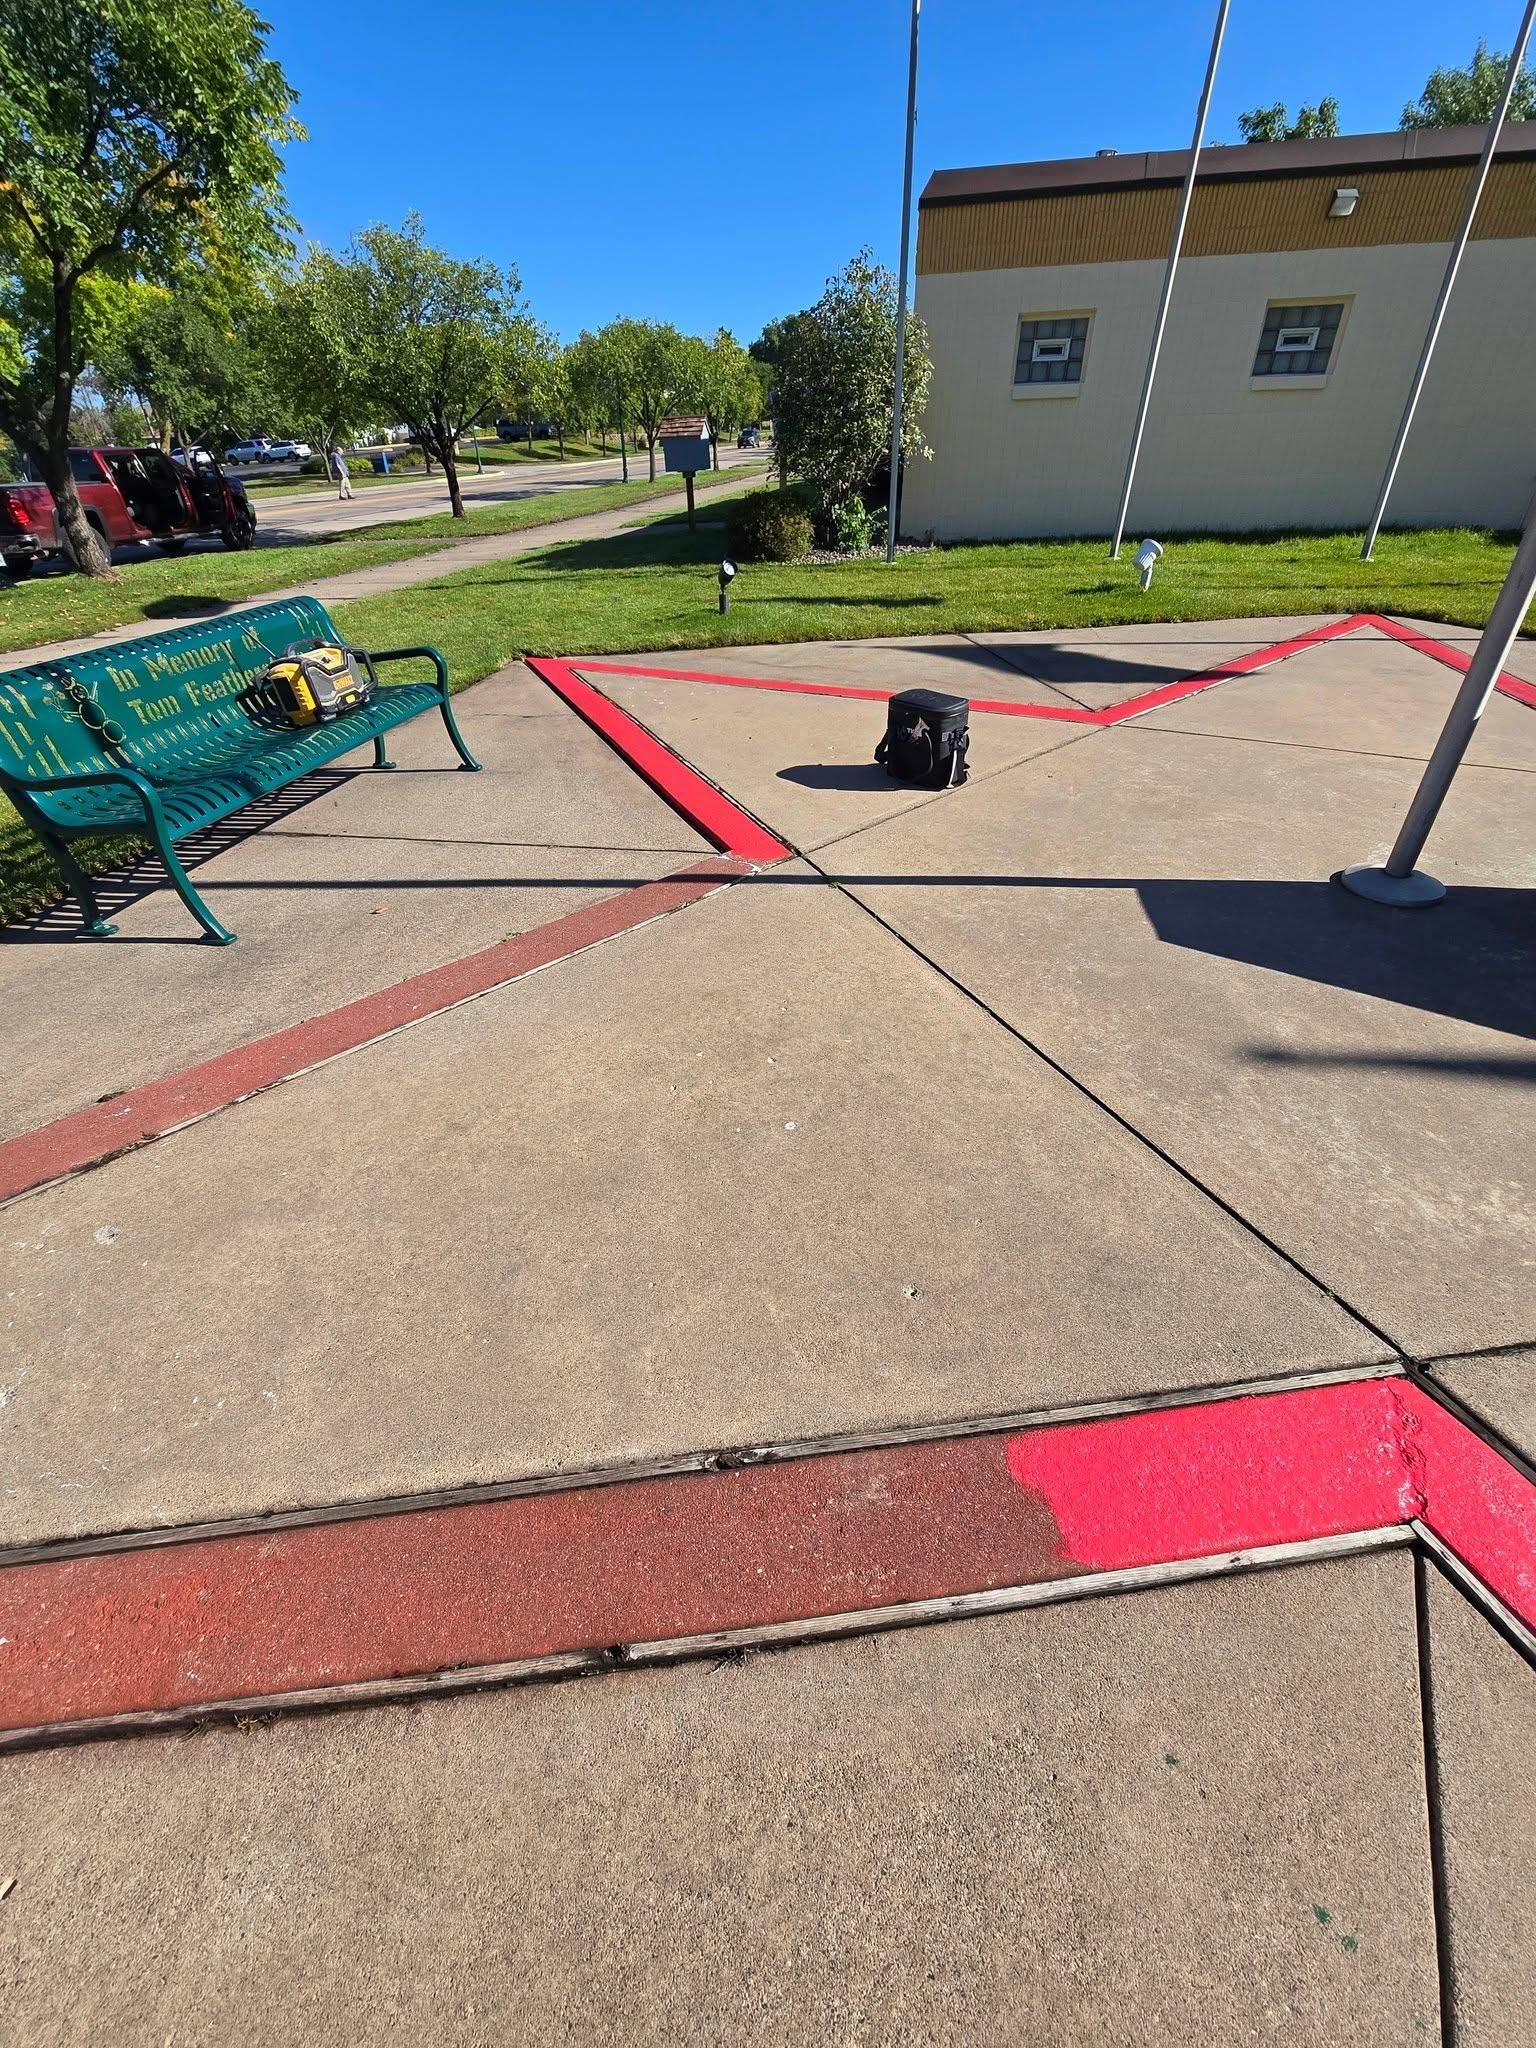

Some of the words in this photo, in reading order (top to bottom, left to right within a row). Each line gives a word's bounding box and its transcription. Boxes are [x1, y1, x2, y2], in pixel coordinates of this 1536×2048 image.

[105, 666, 140, 692] In
[142, 639, 232, 682] Memory
[242, 626, 261, 651] of
[127, 695, 182, 726] Tom
